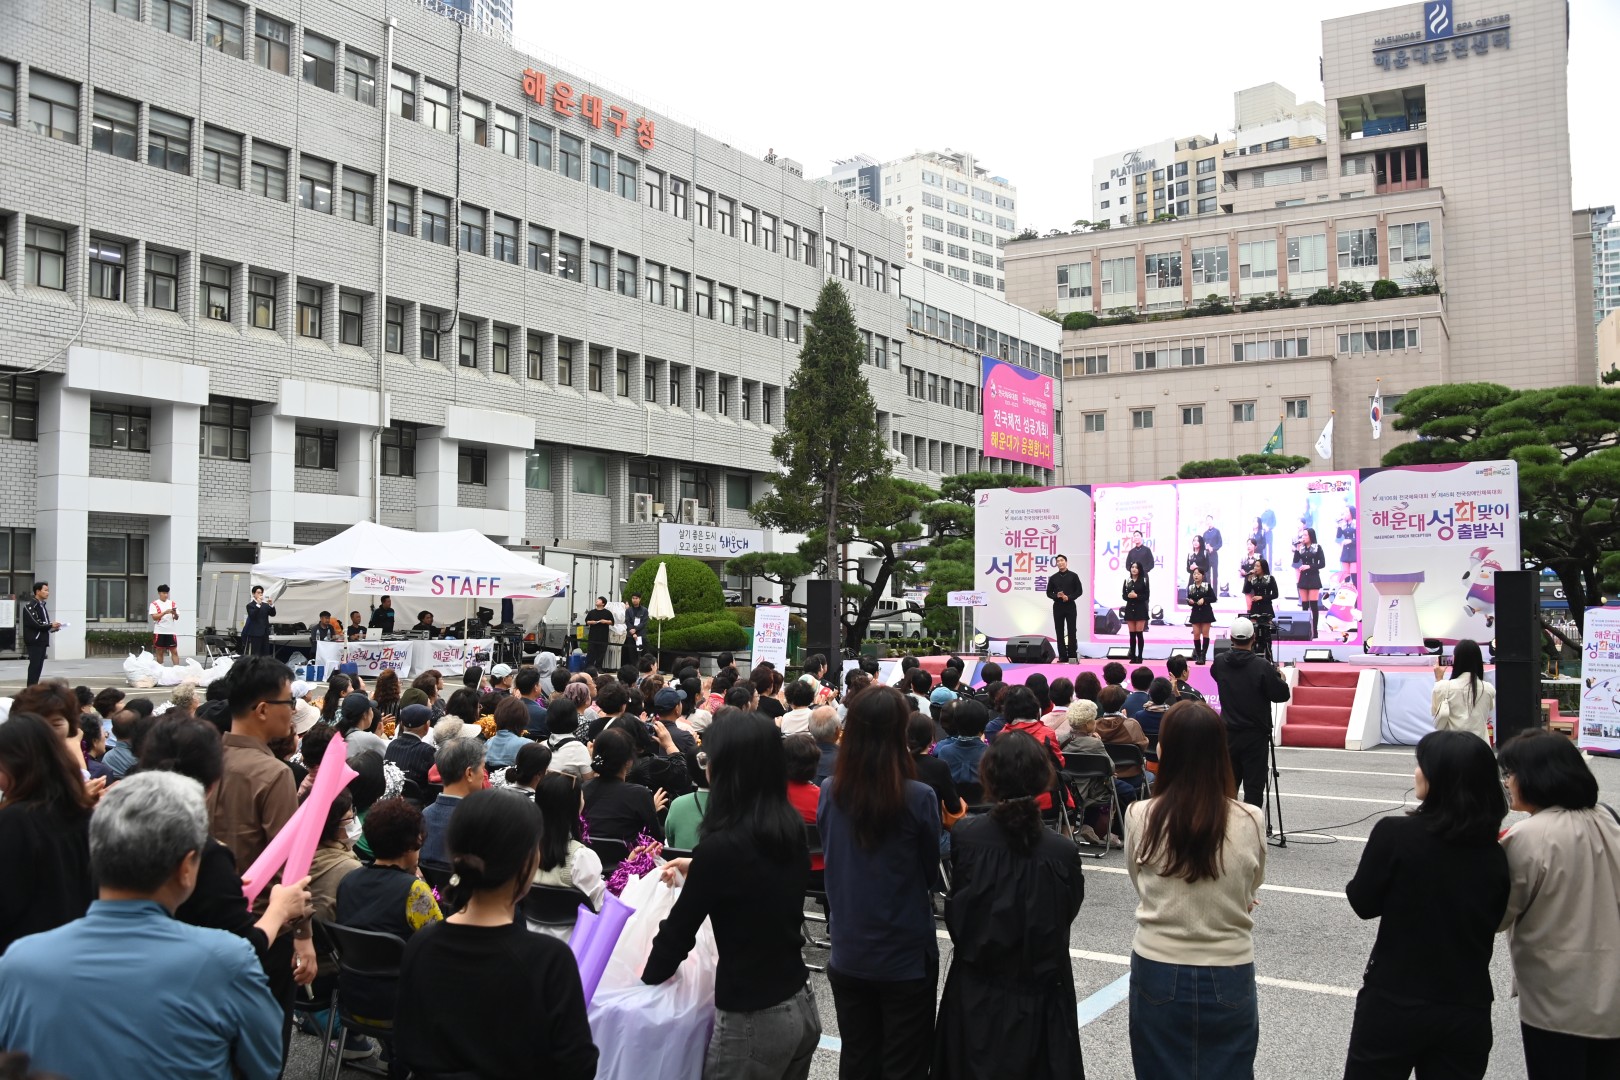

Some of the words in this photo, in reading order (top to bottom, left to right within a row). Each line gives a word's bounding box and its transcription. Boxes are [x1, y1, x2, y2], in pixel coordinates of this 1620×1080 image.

[1374, 31, 1421, 46] HAEUNDAE
[1456, 22, 1473, 31] SPA
[1475, 14, 1510, 27] CENTER
[522, 67, 655, 150] 해운대구청
[1110, 158, 1156, 179] PLATINUM
[993, 409, 1021, 431] 전국체전
[990, 431, 1020, 452] 해운대가
[1021, 437, 1051, 460] 응원합니다
[1115, 516, 1151, 539] 해운대
[1372, 510, 1426, 532] 해운대
[1426, 499, 1510, 541] 성화맞이
[1457, 522, 1504, 540] 출발식
[679, 529, 691, 539] 살기
[692, 530, 704, 541] 좋은
[705, 531, 717, 540] 도시
[719, 534, 749, 553] 해운대
[1005, 528, 1057, 555] 해운대
[679, 541, 691, 551] 오고
[692, 542, 704, 553] 싶은
[705, 543, 717, 553] 도시
[431, 574, 500, 596] STAFF
[433, 648, 460, 662] 해운대
